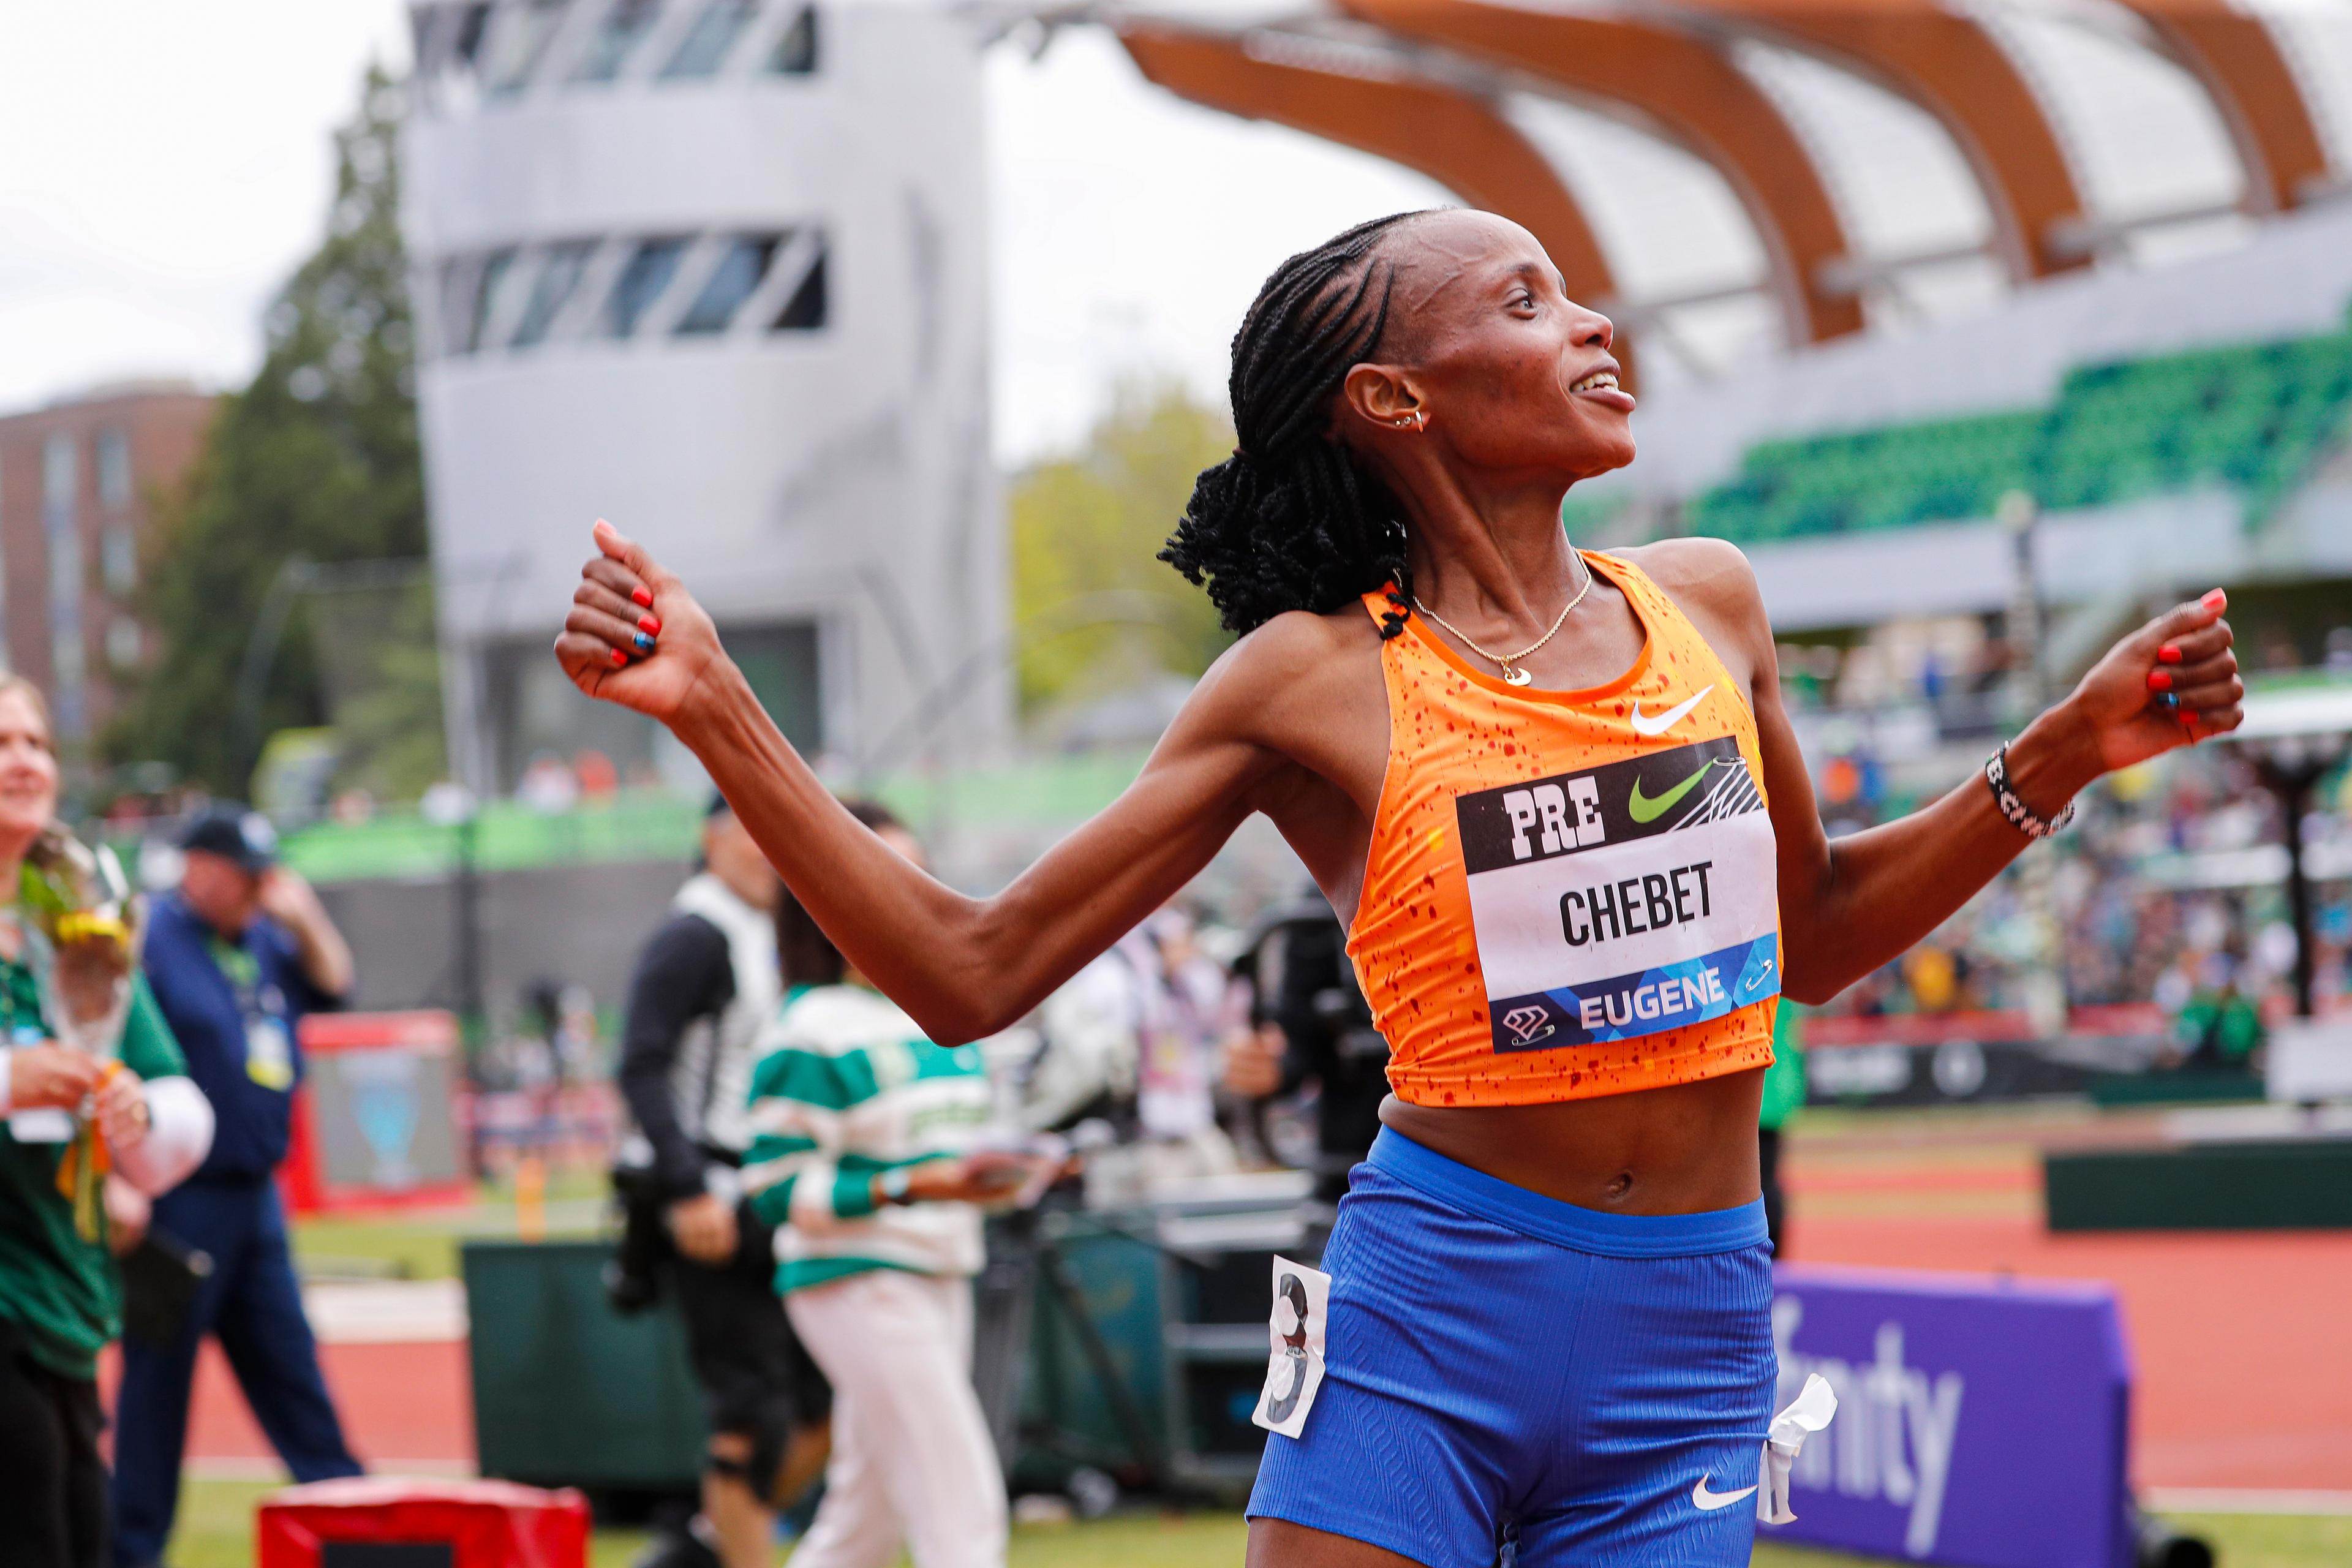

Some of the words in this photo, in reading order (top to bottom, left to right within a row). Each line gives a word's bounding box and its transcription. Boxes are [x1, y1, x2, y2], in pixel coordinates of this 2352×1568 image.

[1503, 775, 1605, 860] PRE
[1559, 861, 1713, 947] CHEBET
[1579, 967, 1724, 1030] EUGENE
[1773, 1294, 1964, 1559] finity
